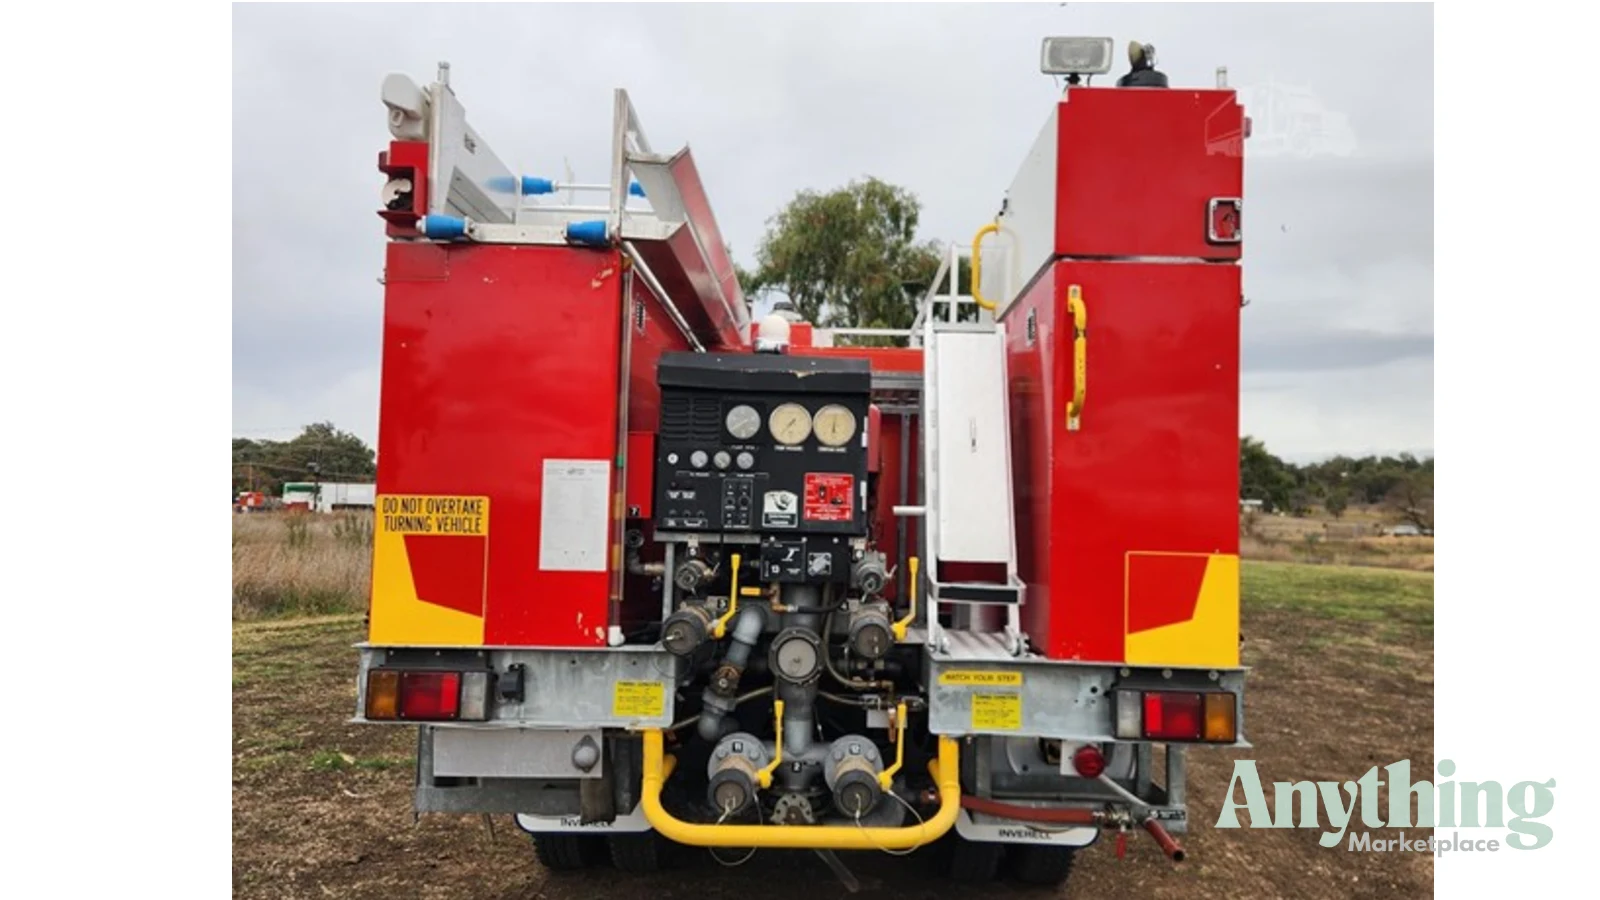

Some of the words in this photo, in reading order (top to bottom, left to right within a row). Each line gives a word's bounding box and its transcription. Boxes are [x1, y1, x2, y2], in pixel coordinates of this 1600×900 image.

[382, 497, 399, 514] DO
[401, 497, 422, 514] NOT
[426, 498, 482, 515] OVERTAKE
[384, 515, 432, 532] TURNING
[436, 516, 482, 533] VEHICLE
[973, 674, 995, 682] YOUR
[997, 674, 1016, 683] STEP
